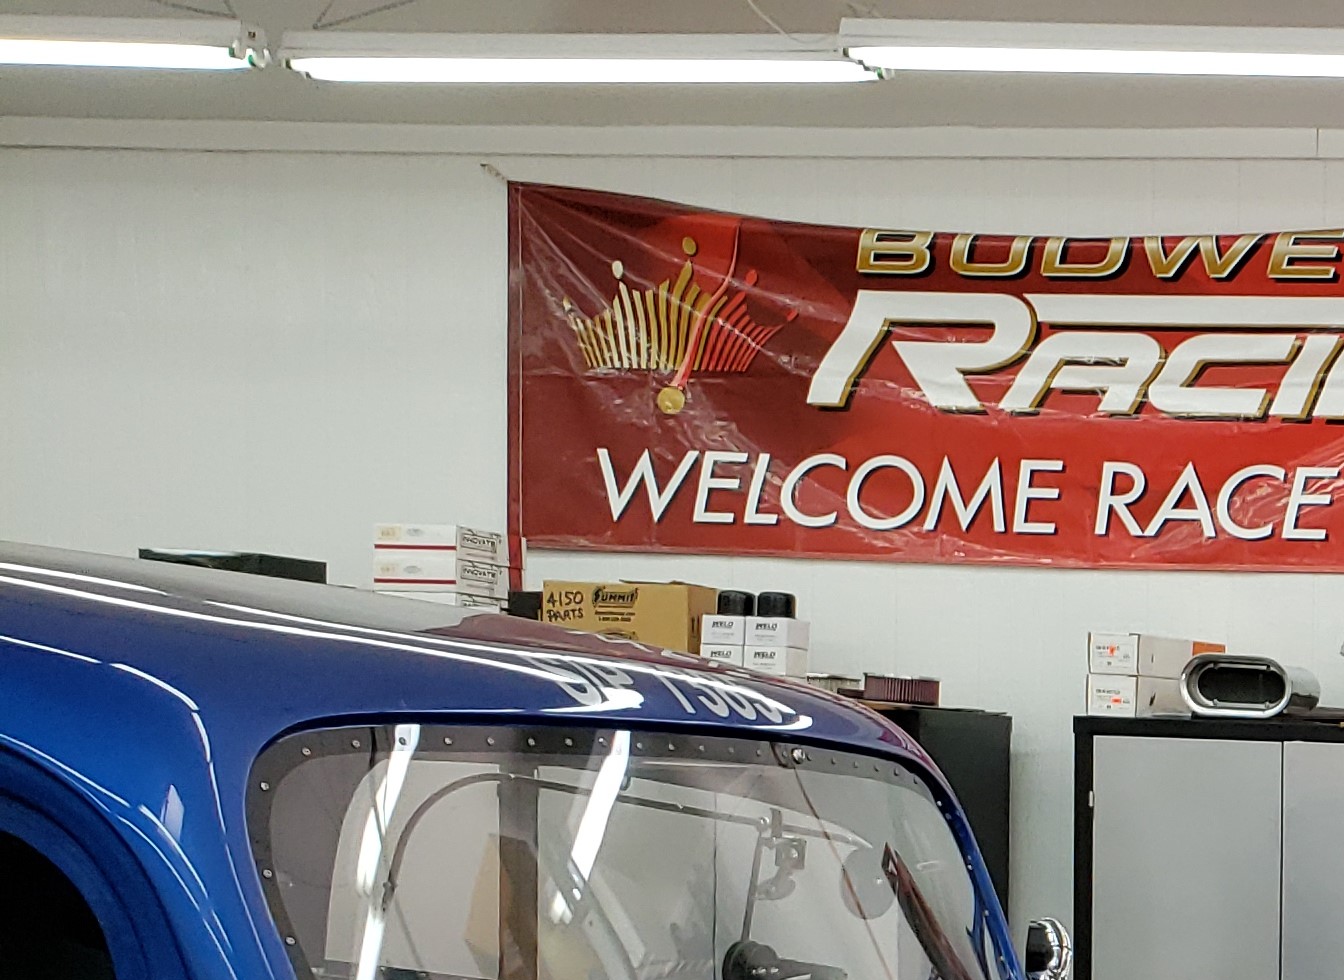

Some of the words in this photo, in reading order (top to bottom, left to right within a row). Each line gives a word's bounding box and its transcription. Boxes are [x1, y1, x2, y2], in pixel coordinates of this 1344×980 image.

[596, 446, 1066, 536] WELCOME
[1094, 461, 1341, 543] RACE
[546, 591, 585, 608] 4150
[592, 585, 638, 607] SUMMIT
[546, 607, 585, 622] PARTS
